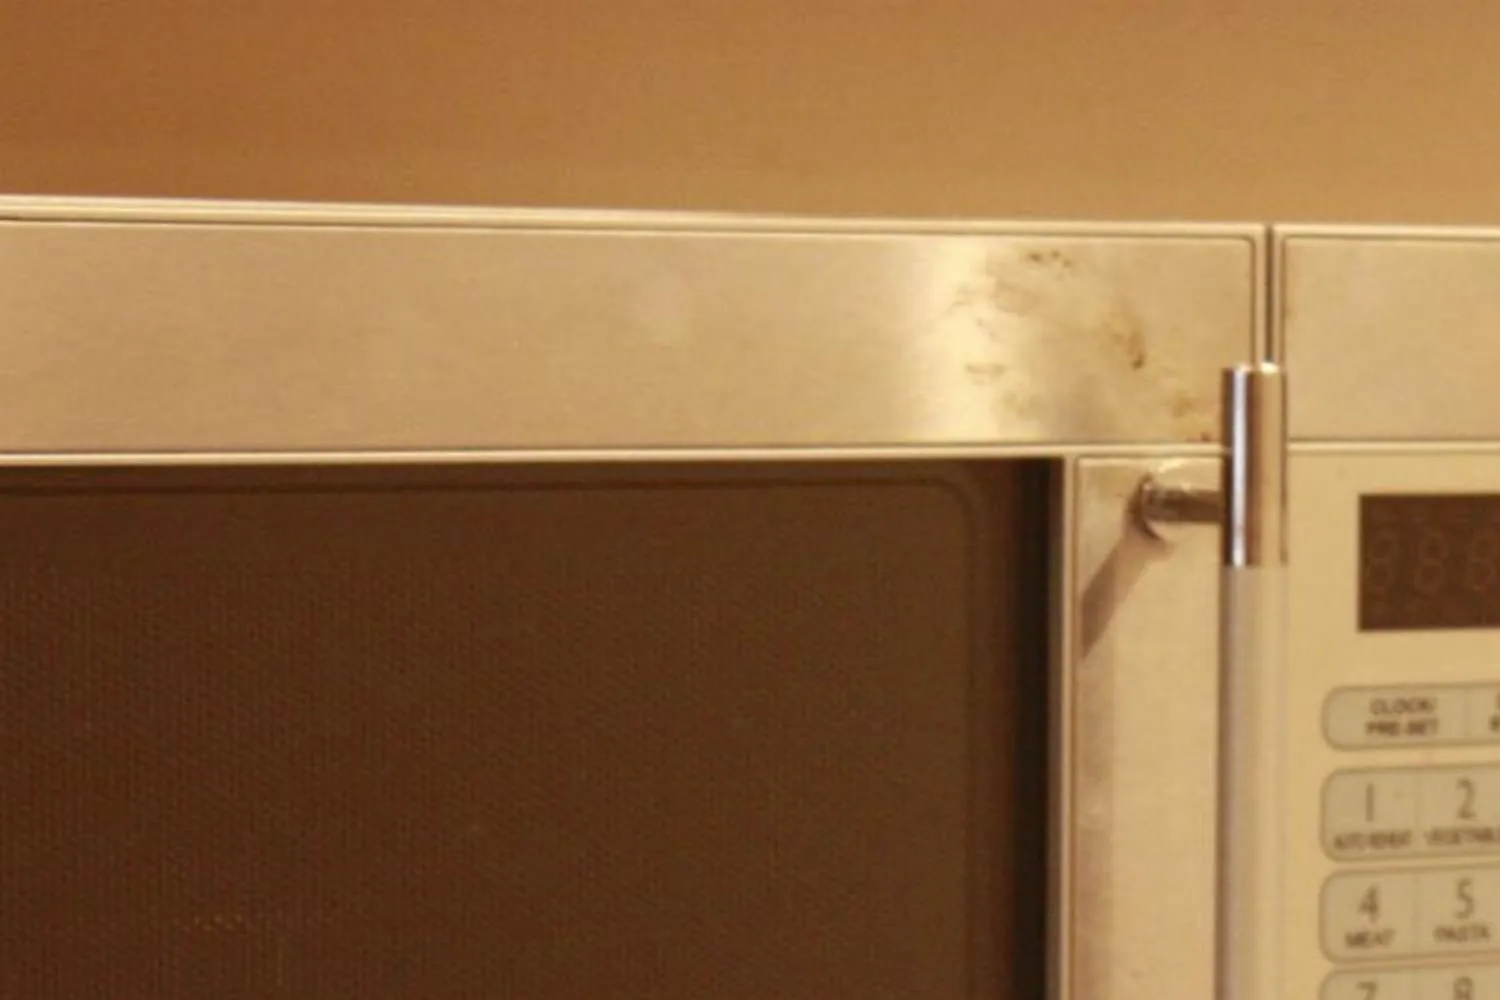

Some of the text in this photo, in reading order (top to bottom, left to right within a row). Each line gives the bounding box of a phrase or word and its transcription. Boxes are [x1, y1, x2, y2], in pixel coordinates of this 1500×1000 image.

[1455, 776, 1476, 821] 2
[1358, 884, 1380, 923] 4
[1455, 876, 1475, 919] 5
